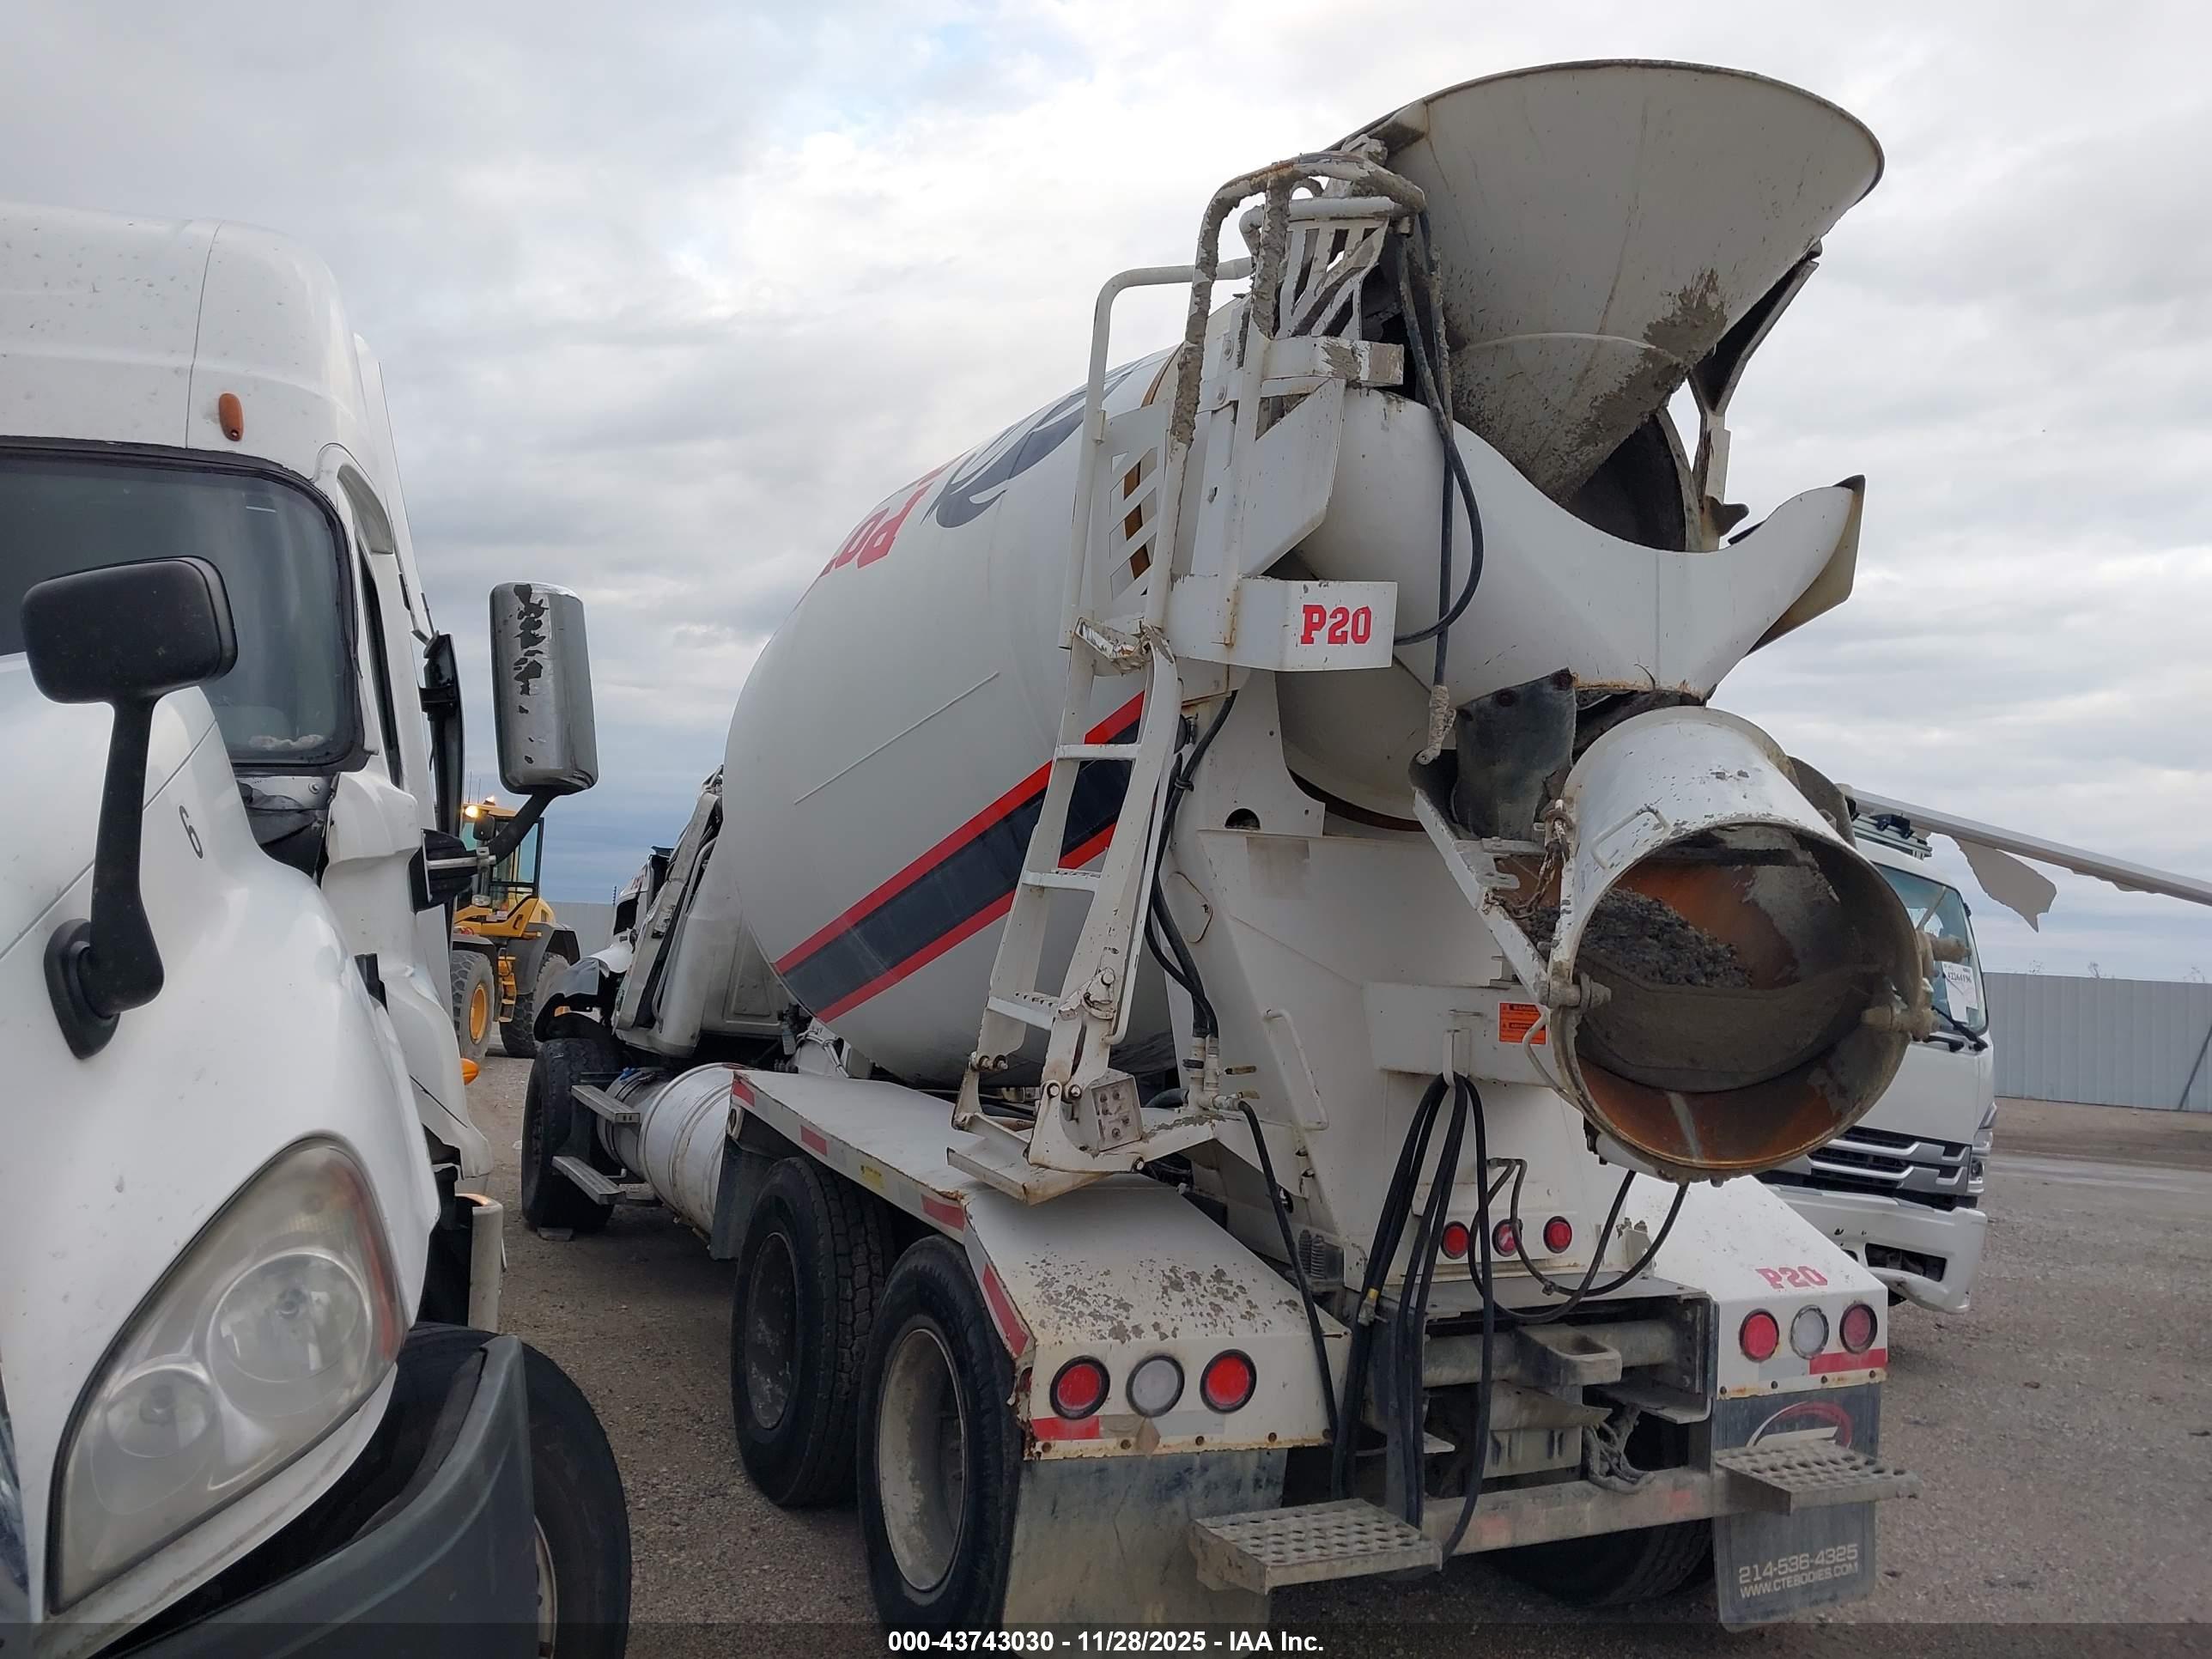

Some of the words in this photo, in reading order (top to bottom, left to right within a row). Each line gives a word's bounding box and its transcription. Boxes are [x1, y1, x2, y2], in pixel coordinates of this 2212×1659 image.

[1300, 604, 1372, 645] P20
[179, 805, 204, 860] 6
[1755, 1266, 1828, 1289] P20
[1739, 1544, 1859, 1584] 214-536-4325
[1740, 1562, 1859, 1599] WWW.CTEBODIES.COM
